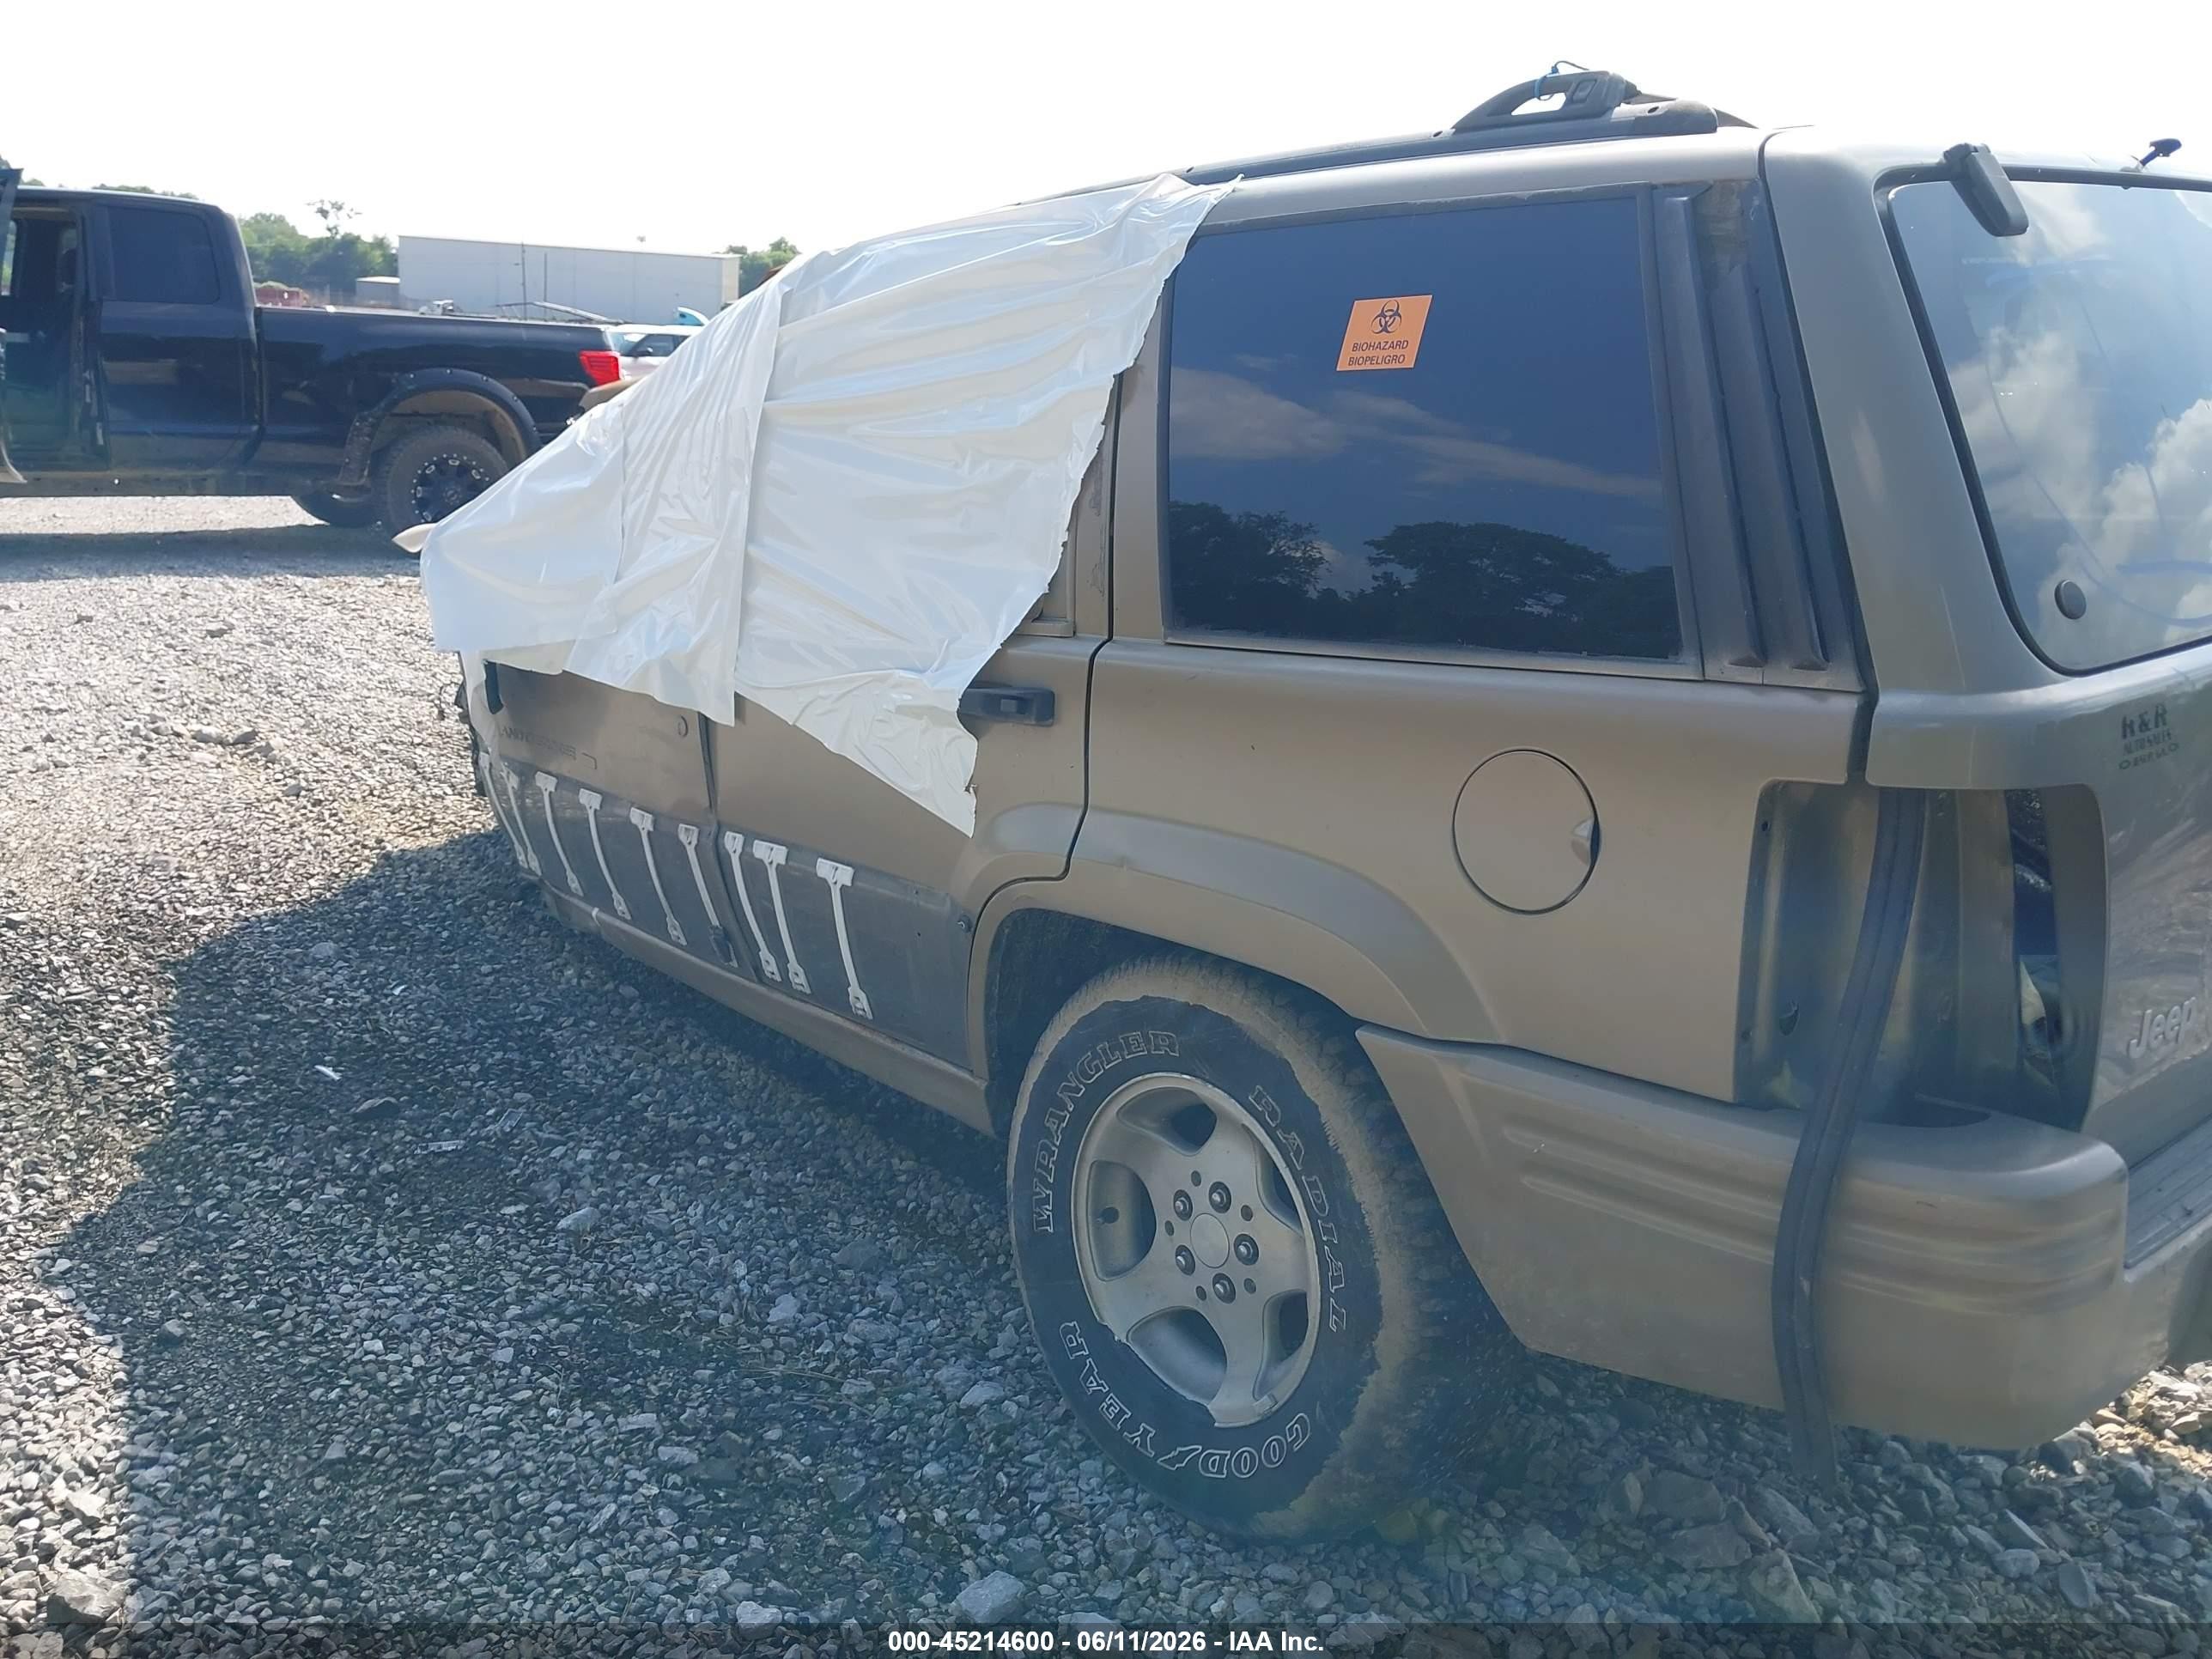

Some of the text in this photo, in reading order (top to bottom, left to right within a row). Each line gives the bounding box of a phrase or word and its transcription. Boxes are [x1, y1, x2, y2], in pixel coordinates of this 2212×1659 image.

[1348, 355, 1406, 367] BIOPELIGRO
[1352, 340, 1409, 352] BIOHAZARD
[2127, 996, 2197, 1059] Jeep
[1032, 1029, 1181, 1234] WRANGLER
[1248, 1085, 1347, 1334] RADIAL
[1058, 1320, 1312, 1480] GOODYEAR
